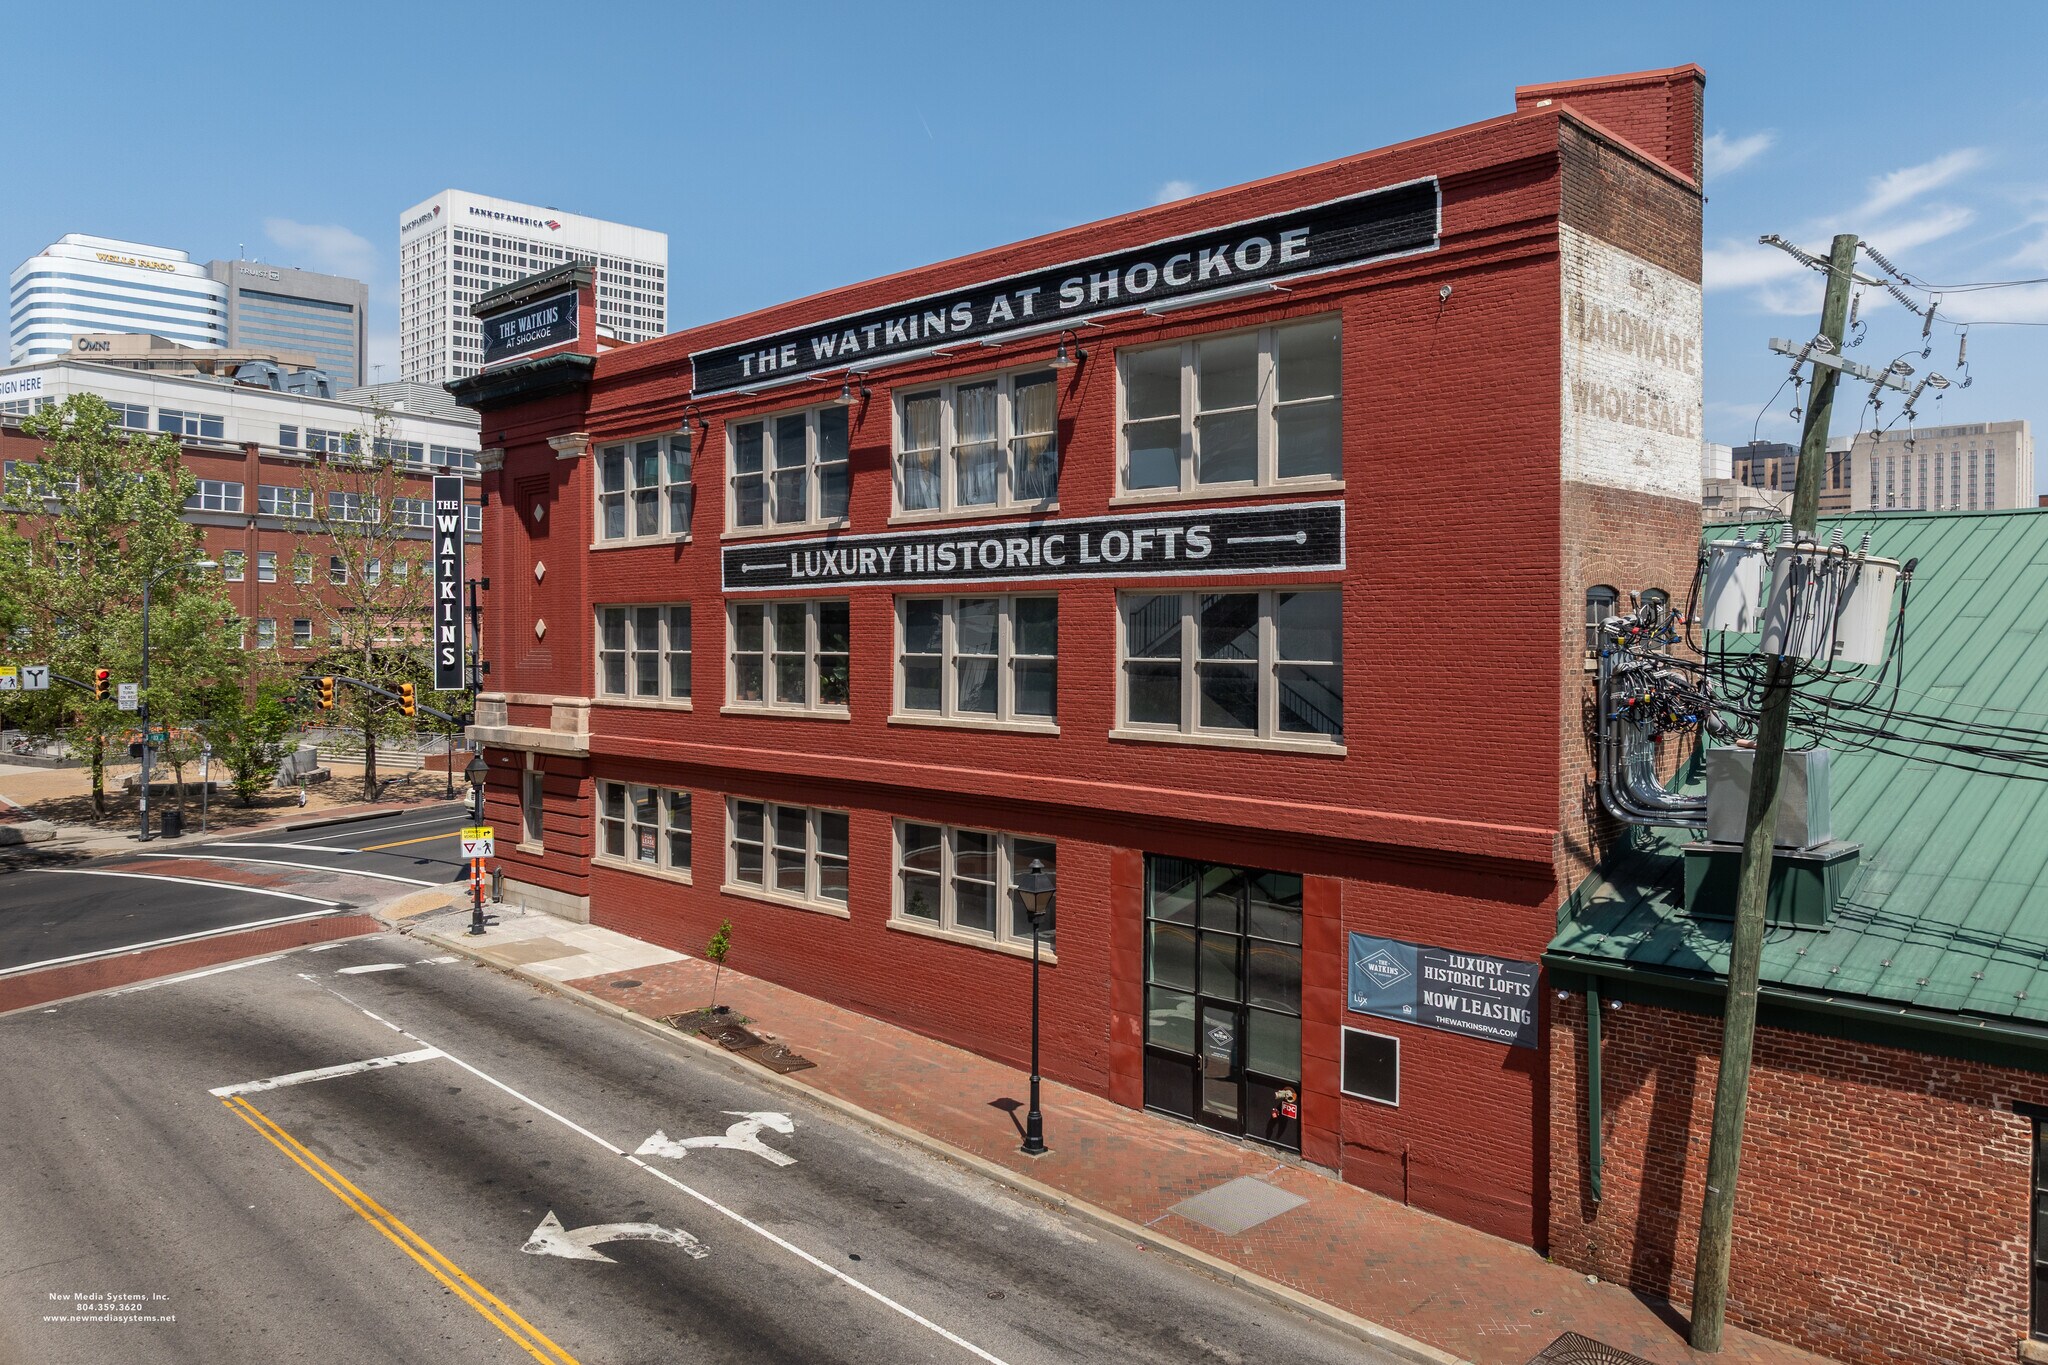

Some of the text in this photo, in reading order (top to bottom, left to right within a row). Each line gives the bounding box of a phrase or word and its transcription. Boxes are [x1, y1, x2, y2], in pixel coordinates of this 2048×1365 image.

[469, 206, 544, 229] BANK OF AMERICA
[96, 252, 176, 272] WELLS FARGO
[239, 266, 268, 278] TRUIST
[738, 227, 1311, 377] THE WATKINS AT SHOCKOE
[500, 306, 559, 339] THE WATKINS
[506, 326, 551, 349] AT SHOCKOE
[20, 377, 42, 392] HERE
[1570, 379, 1696, 439] WHOLESALE
[437, 500, 459, 510] THE
[791, 525, 1212, 577] LUXURY HISTORIC LOFTS
[436, 515, 459, 666] WATKINS
[1367, 963, 1399, 976] WATKINS
[1378, 959, 1388, 967] THE
[1449, 955, 1504, 976] LUXURY
[1424, 966, 1531, 998] HISTORIC LOFTS
[1424, 990, 1531, 1025] NOW LEASING
[1435, 1015, 1518, 1039] THEWATKINSRVA.COM
